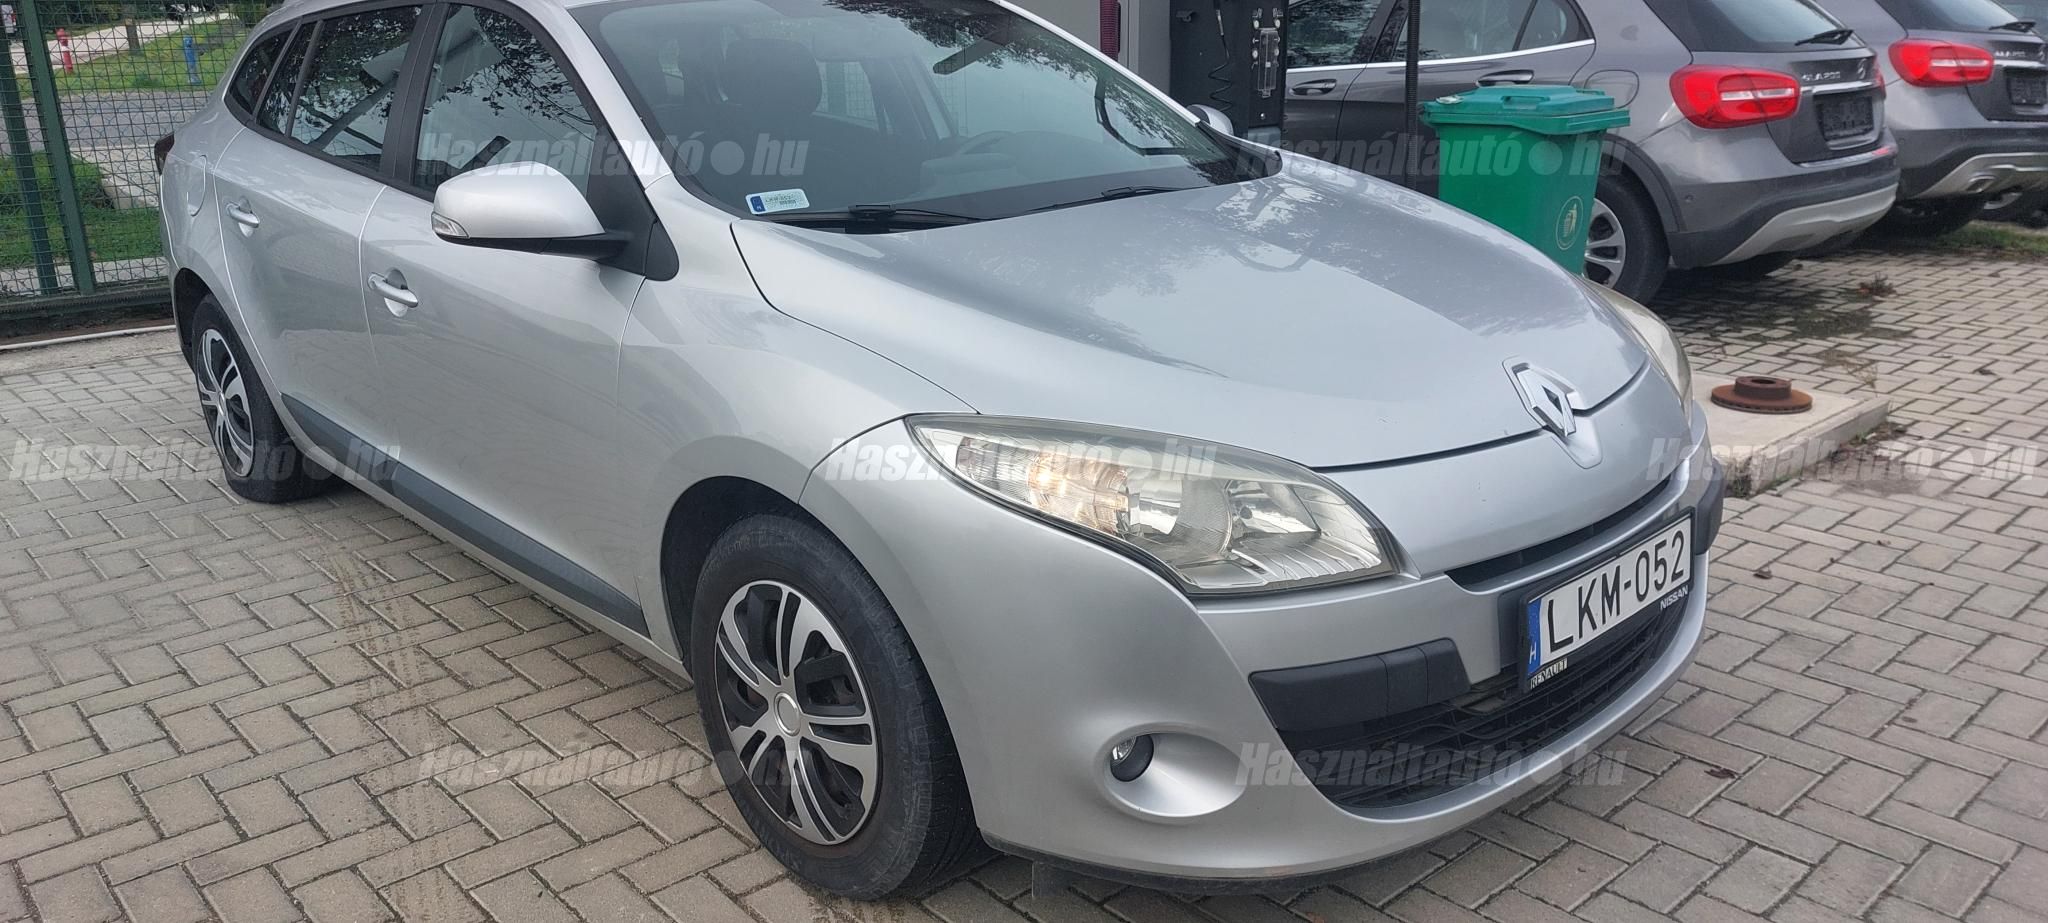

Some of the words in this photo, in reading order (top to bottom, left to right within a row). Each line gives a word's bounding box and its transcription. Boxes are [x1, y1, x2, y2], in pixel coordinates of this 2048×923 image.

[1548, 530, 1684, 652] LKM-052
[1660, 584, 1689, 611] NISSAN
[1529, 641, 1537, 664] H
[1530, 657, 1568, 690] RENAULT
